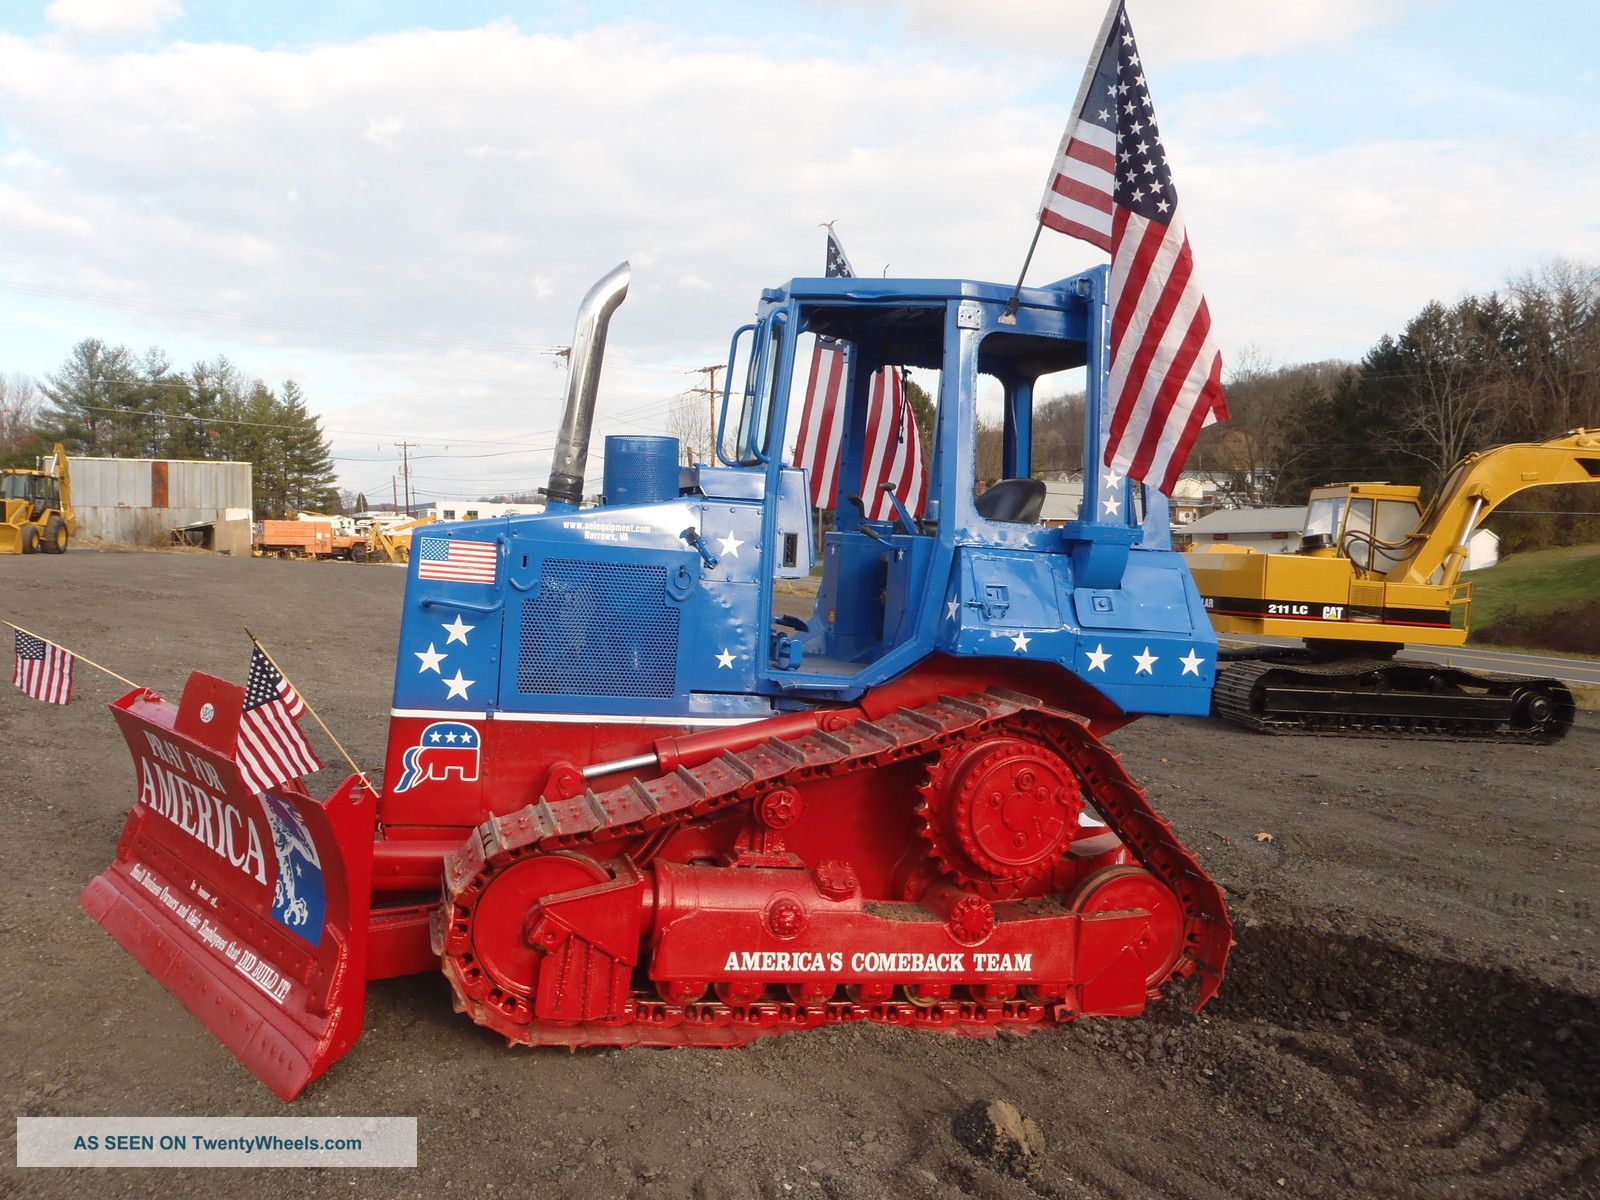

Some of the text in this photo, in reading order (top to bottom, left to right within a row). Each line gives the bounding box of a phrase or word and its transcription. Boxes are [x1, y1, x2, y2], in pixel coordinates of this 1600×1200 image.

[584, 531, 629, 542] Narrows, VA
[1268, 604, 1308, 615] 211 LC
[1322, 606, 1343, 620] CAT
[144, 730, 227, 794] PRAY FOR
[141, 756, 267, 886] AMERICA
[141, 872, 162, 897] Business
[159, 886, 180, 911] Owners
[176, 904, 191, 919] and
[186, 909, 202, 929] their
[198, 919, 228, 950] Employees
[225, 941, 242, 962] that
[238, 949, 257, 972] DID
[252, 960, 280, 990] BUILD
[274, 977, 292, 1000] IT!
[724, 951, 1032, 972] AMERICA'S COMEBACK TEAM
